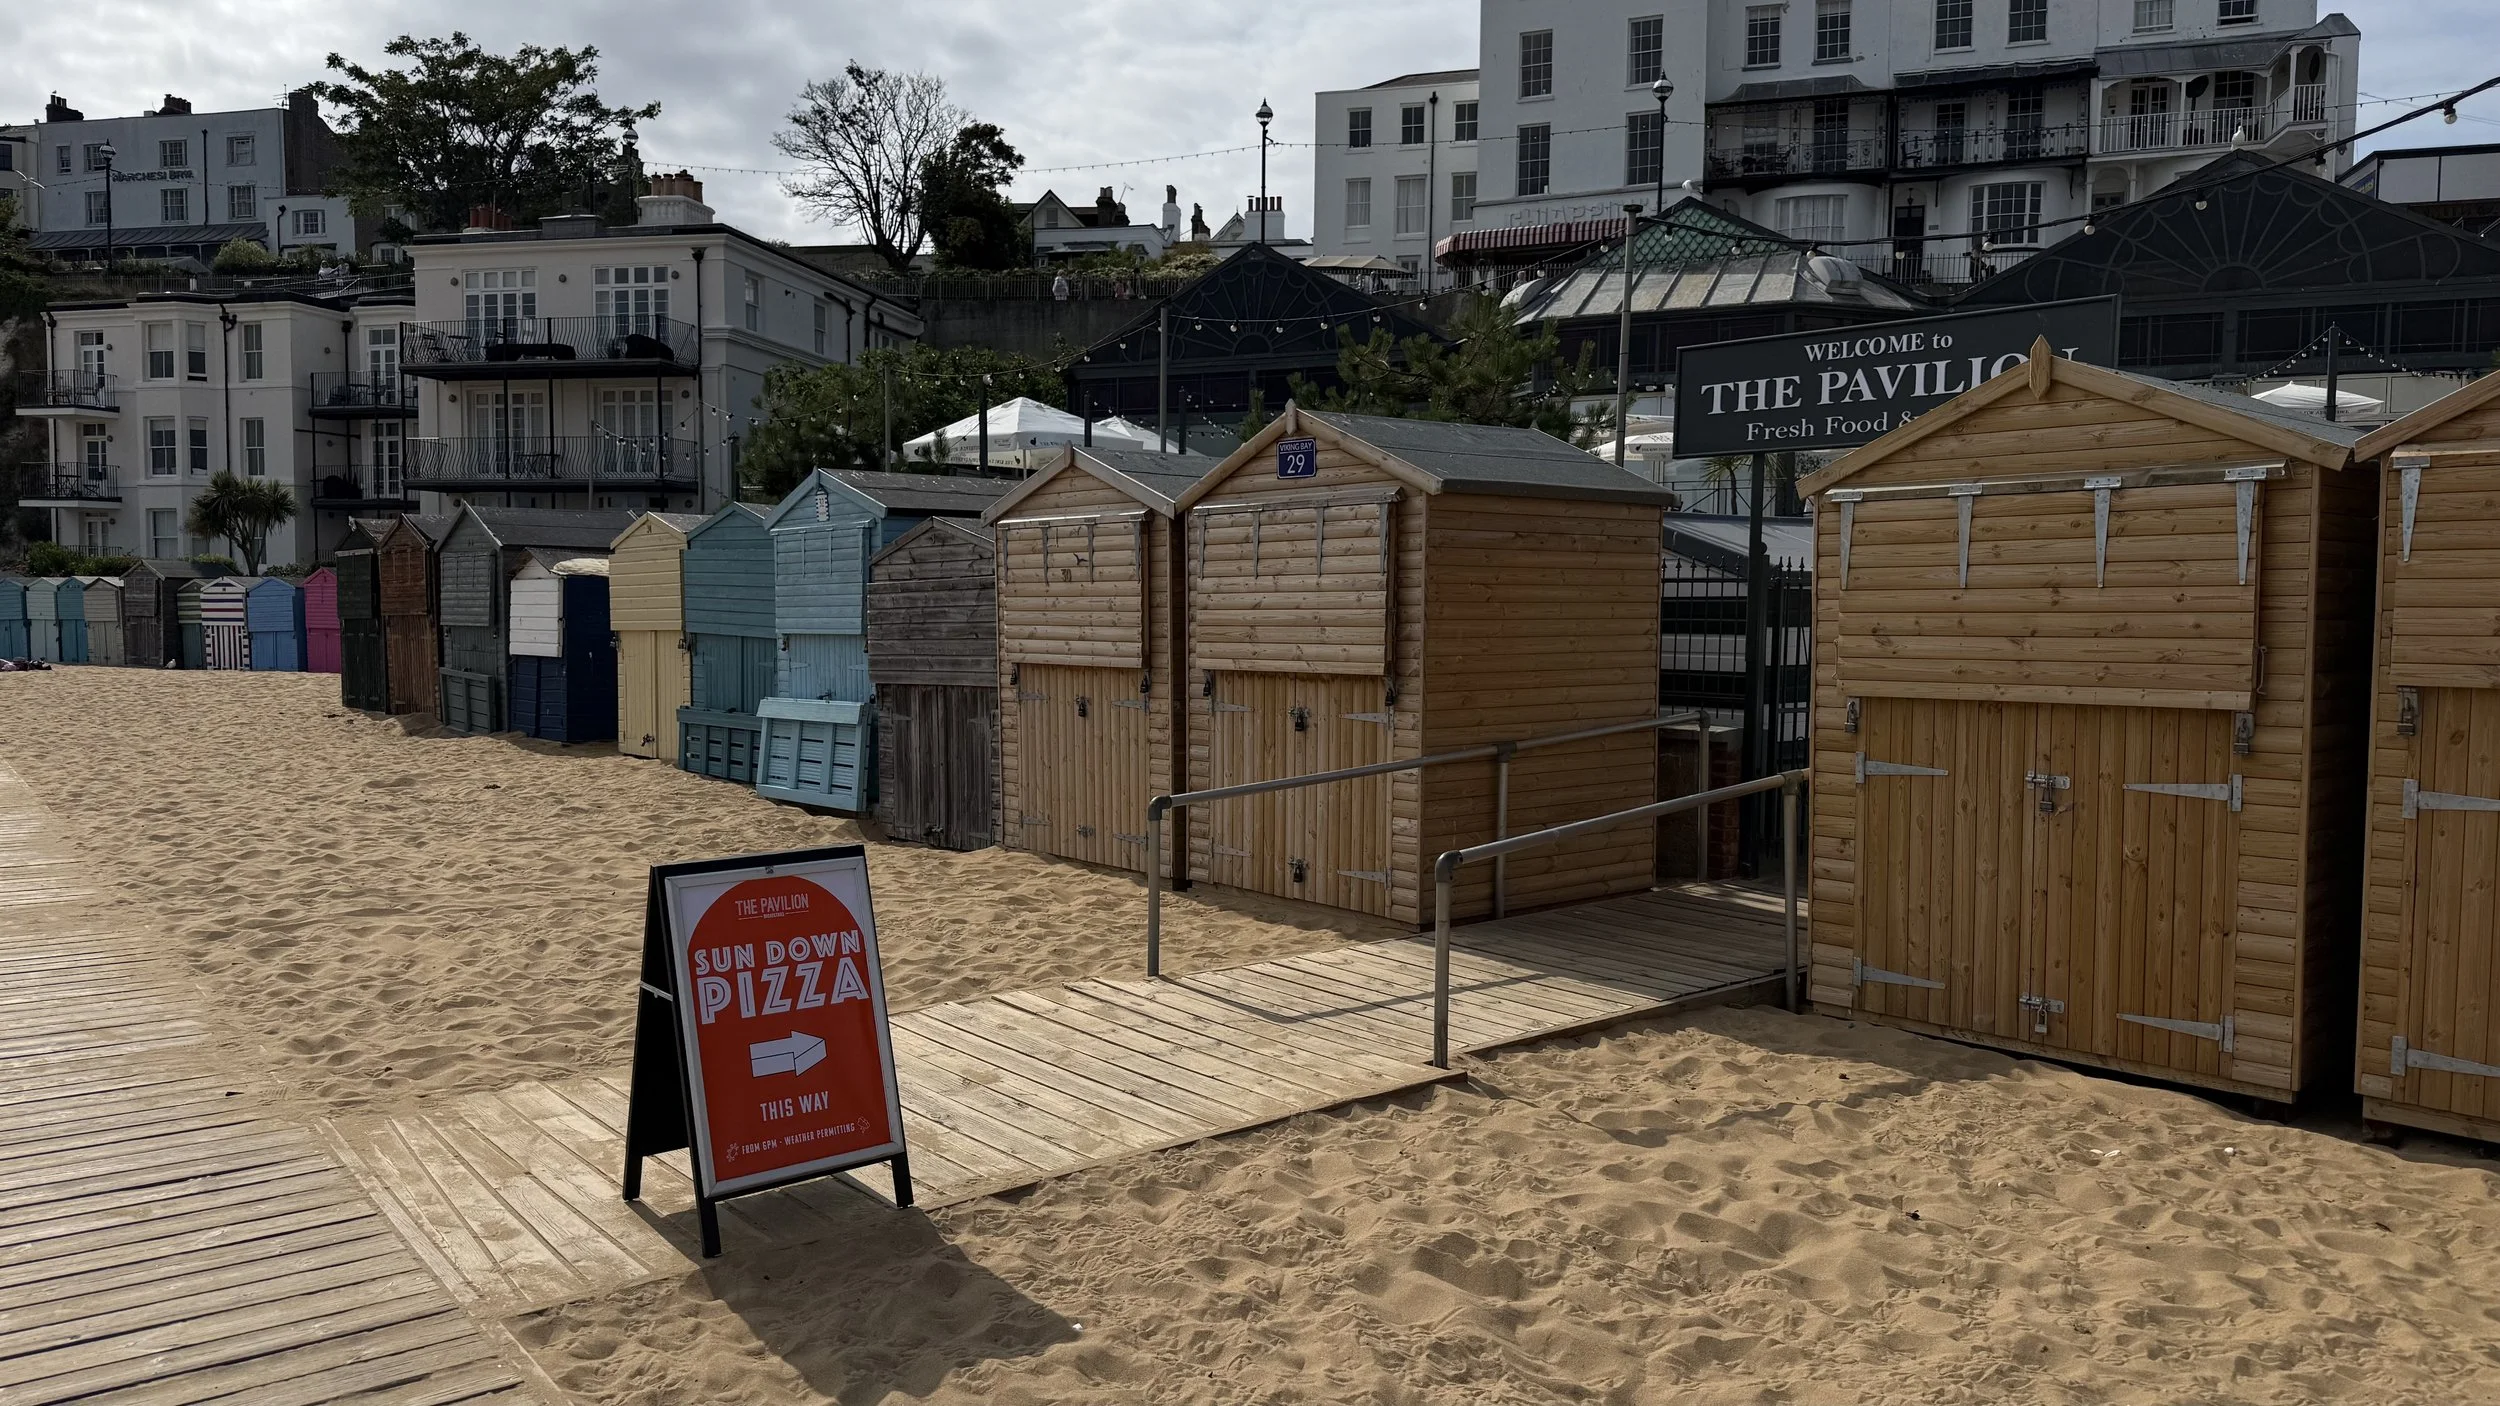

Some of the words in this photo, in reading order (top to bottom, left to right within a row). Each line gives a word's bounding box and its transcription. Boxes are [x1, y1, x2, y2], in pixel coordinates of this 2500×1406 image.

[1804, 332, 1924, 362] WELCOME
[1932, 333, 1953, 349] to
[1701, 375, 1802, 416] THE
[1818, 347, 2080, 407] PAVILIO
[1746, 418, 1814, 441] Fresh
[1826, 411, 1888, 436] Food
[1300, 442, 1312, 450] BAY
[1287, 454, 1305, 474] 29
[735, 899, 758, 916] THE
[760, 893, 809, 913] PAVILION
[694, 942, 755, 976] SUN
[766, 930, 861, 967] DOWN
[696, 957, 870, 1025] PIZZA
[760, 1097, 794, 1122] THIS
[798, 1091, 829, 1114] WAY
[742, 1142, 760, 1154] FROM
[762, 1139, 778, 1151] 6PM
[784, 1131, 815, 1146] WEATHER
[817, 1122, 855, 1139] PERMITTING
